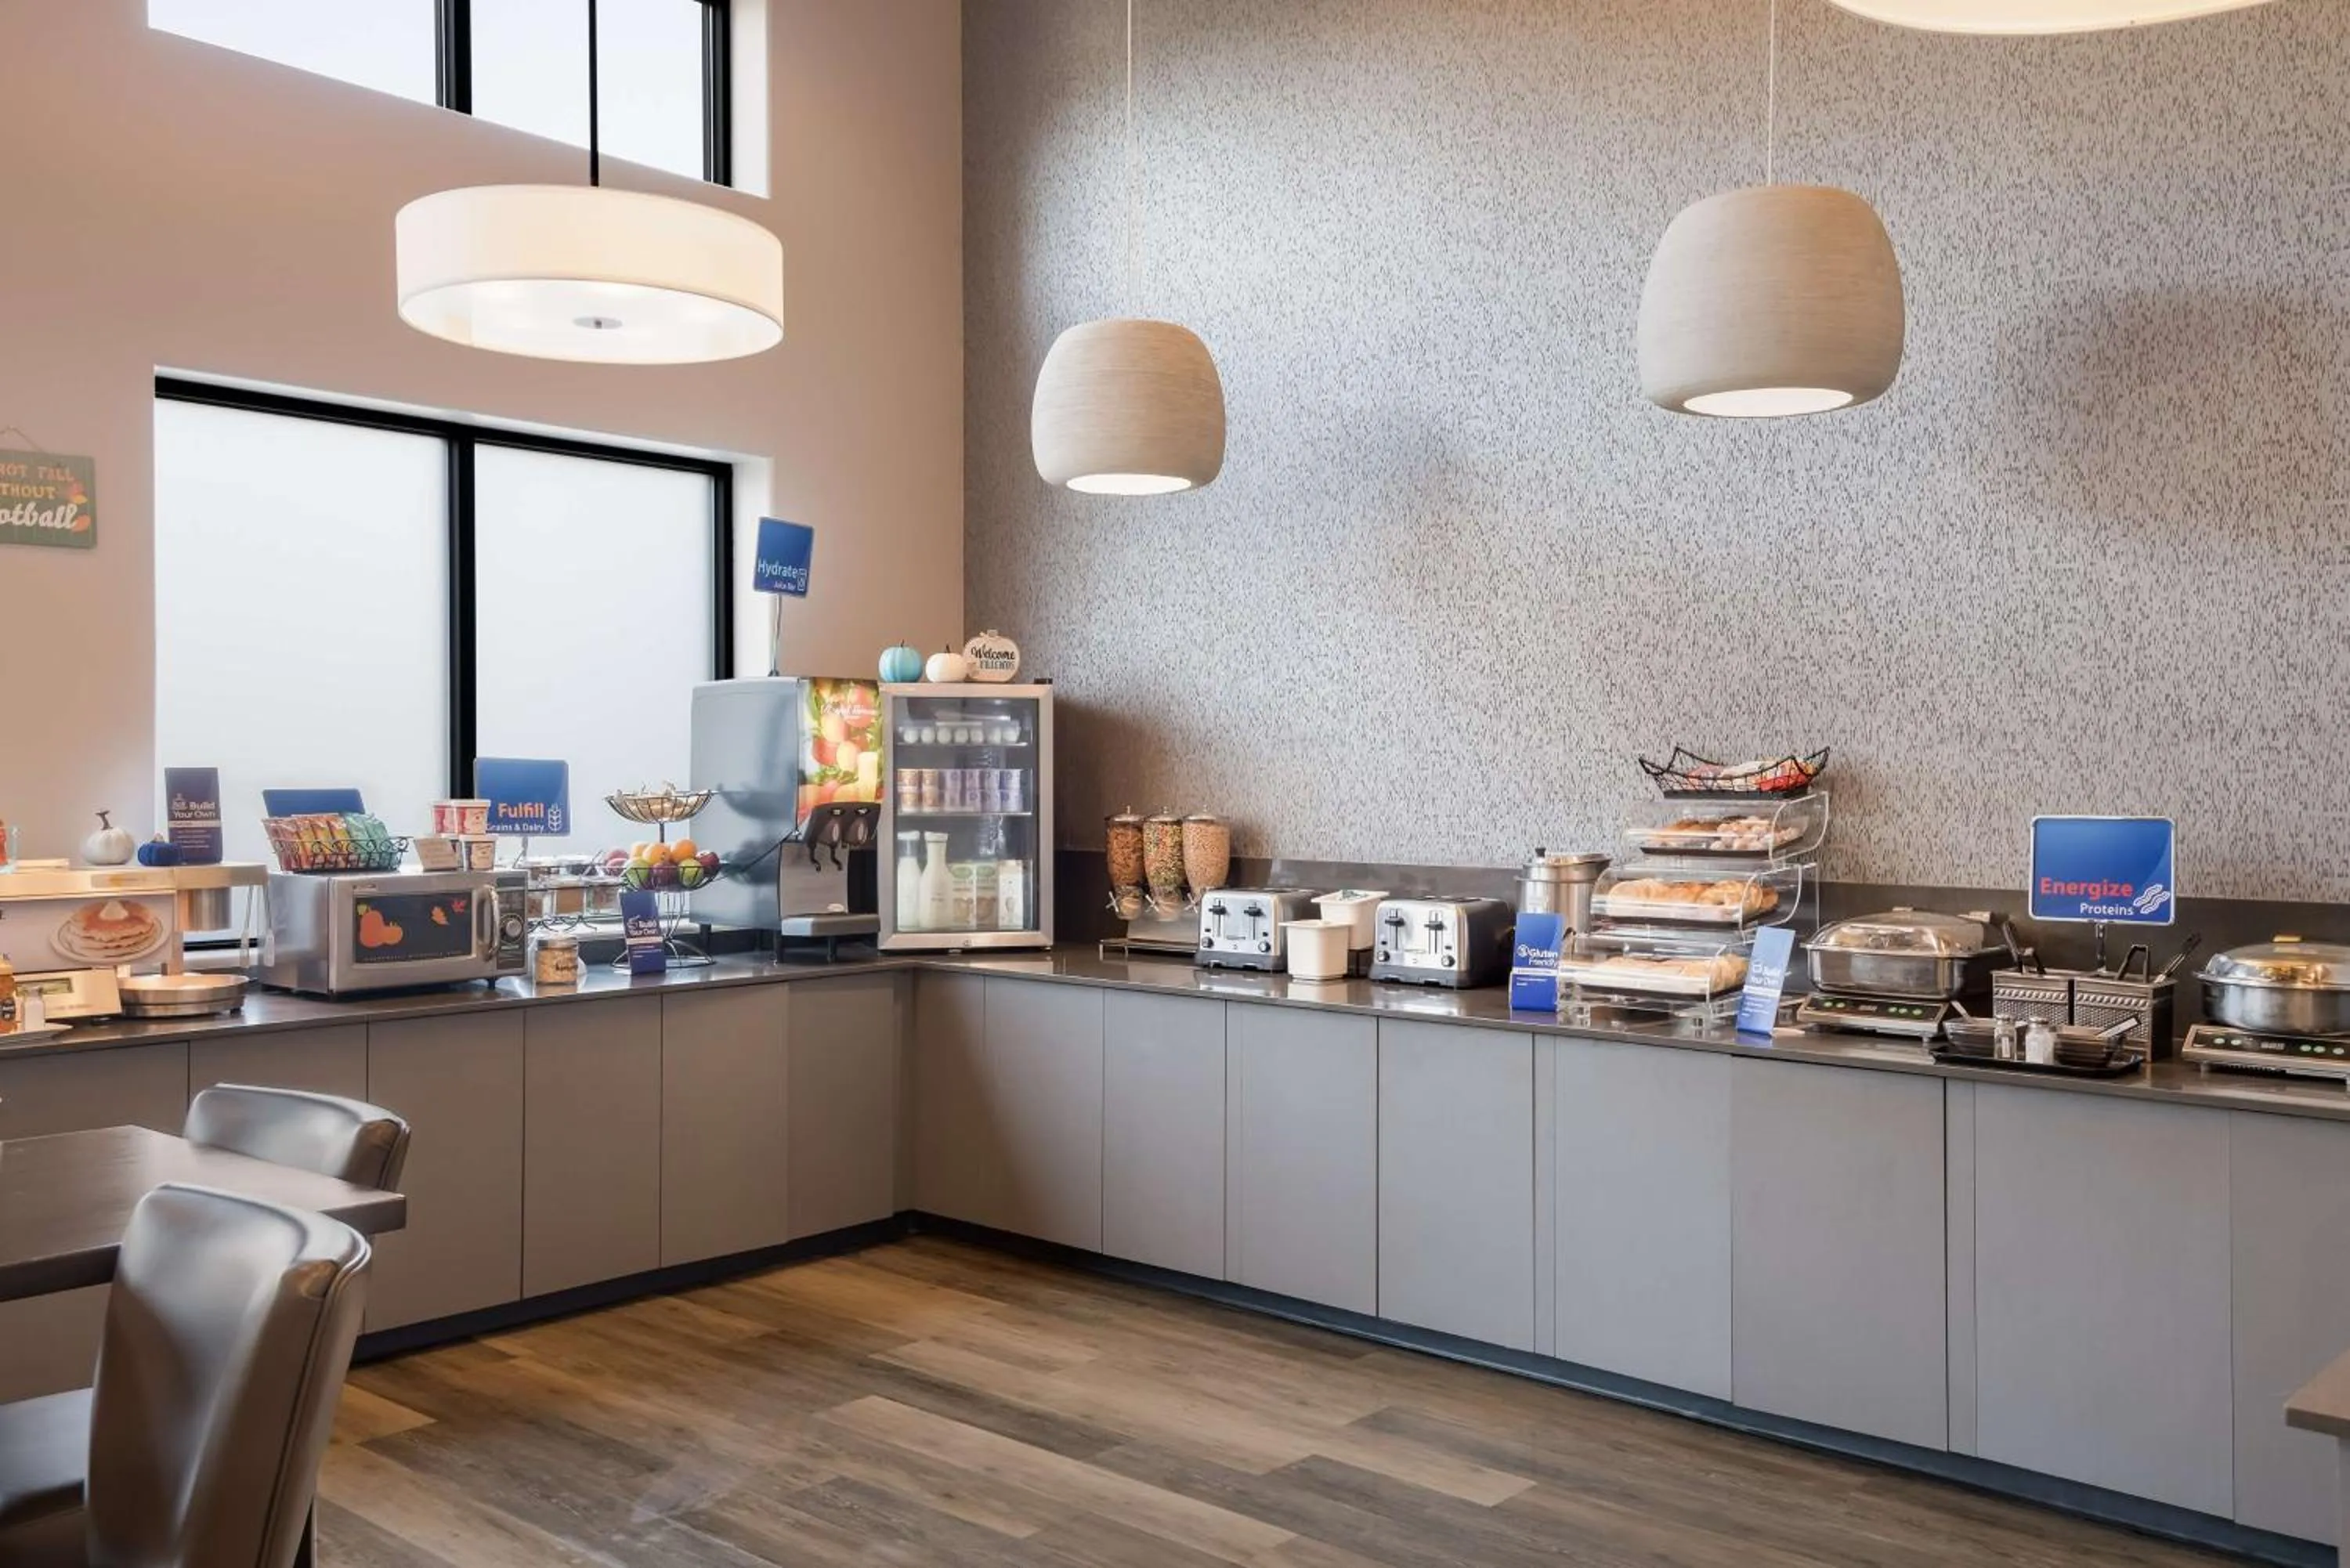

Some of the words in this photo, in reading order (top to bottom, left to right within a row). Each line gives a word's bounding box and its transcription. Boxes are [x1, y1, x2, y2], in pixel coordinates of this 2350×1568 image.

[757, 558, 798, 579] Hydrate
[971, 643, 1016, 660] Welcome
[189, 800, 216, 811] Build
[497, 802, 545, 818] Fulfill
[174, 811, 193, 819] Your
[2040, 876, 2134, 901] Energize
[2079, 901, 2135, 916] Proteins
[1531, 948, 1559, 959] Gluten
[1528, 957, 1559, 968] Friendly
